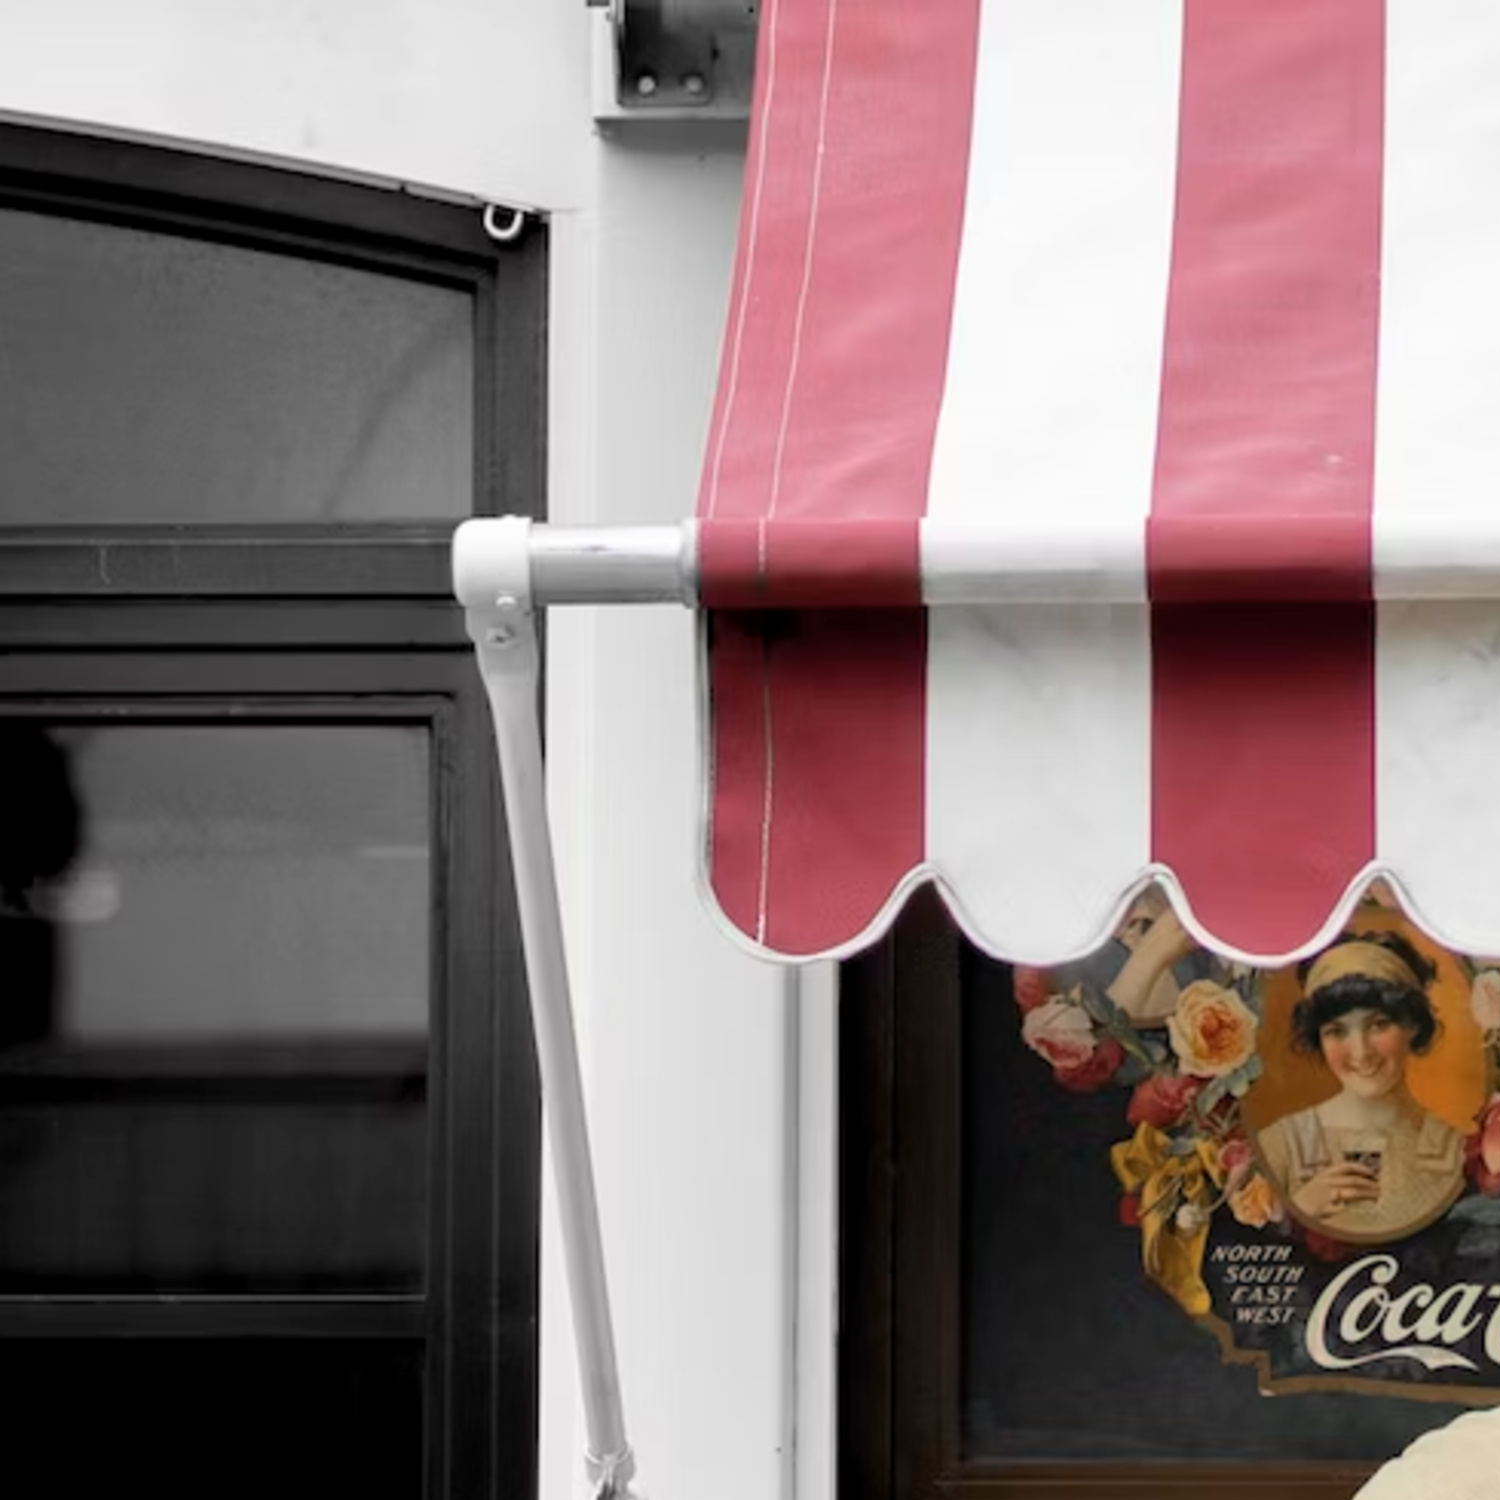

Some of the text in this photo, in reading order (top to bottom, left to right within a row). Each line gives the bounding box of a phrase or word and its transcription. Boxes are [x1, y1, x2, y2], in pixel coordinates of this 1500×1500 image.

[1211, 1245, 1294, 1262] NORTH
[1222, 1265, 1305, 1283] SOUTH
[1231, 1285, 1298, 1304] EAST
[1236, 1306, 1296, 1324] WEST
